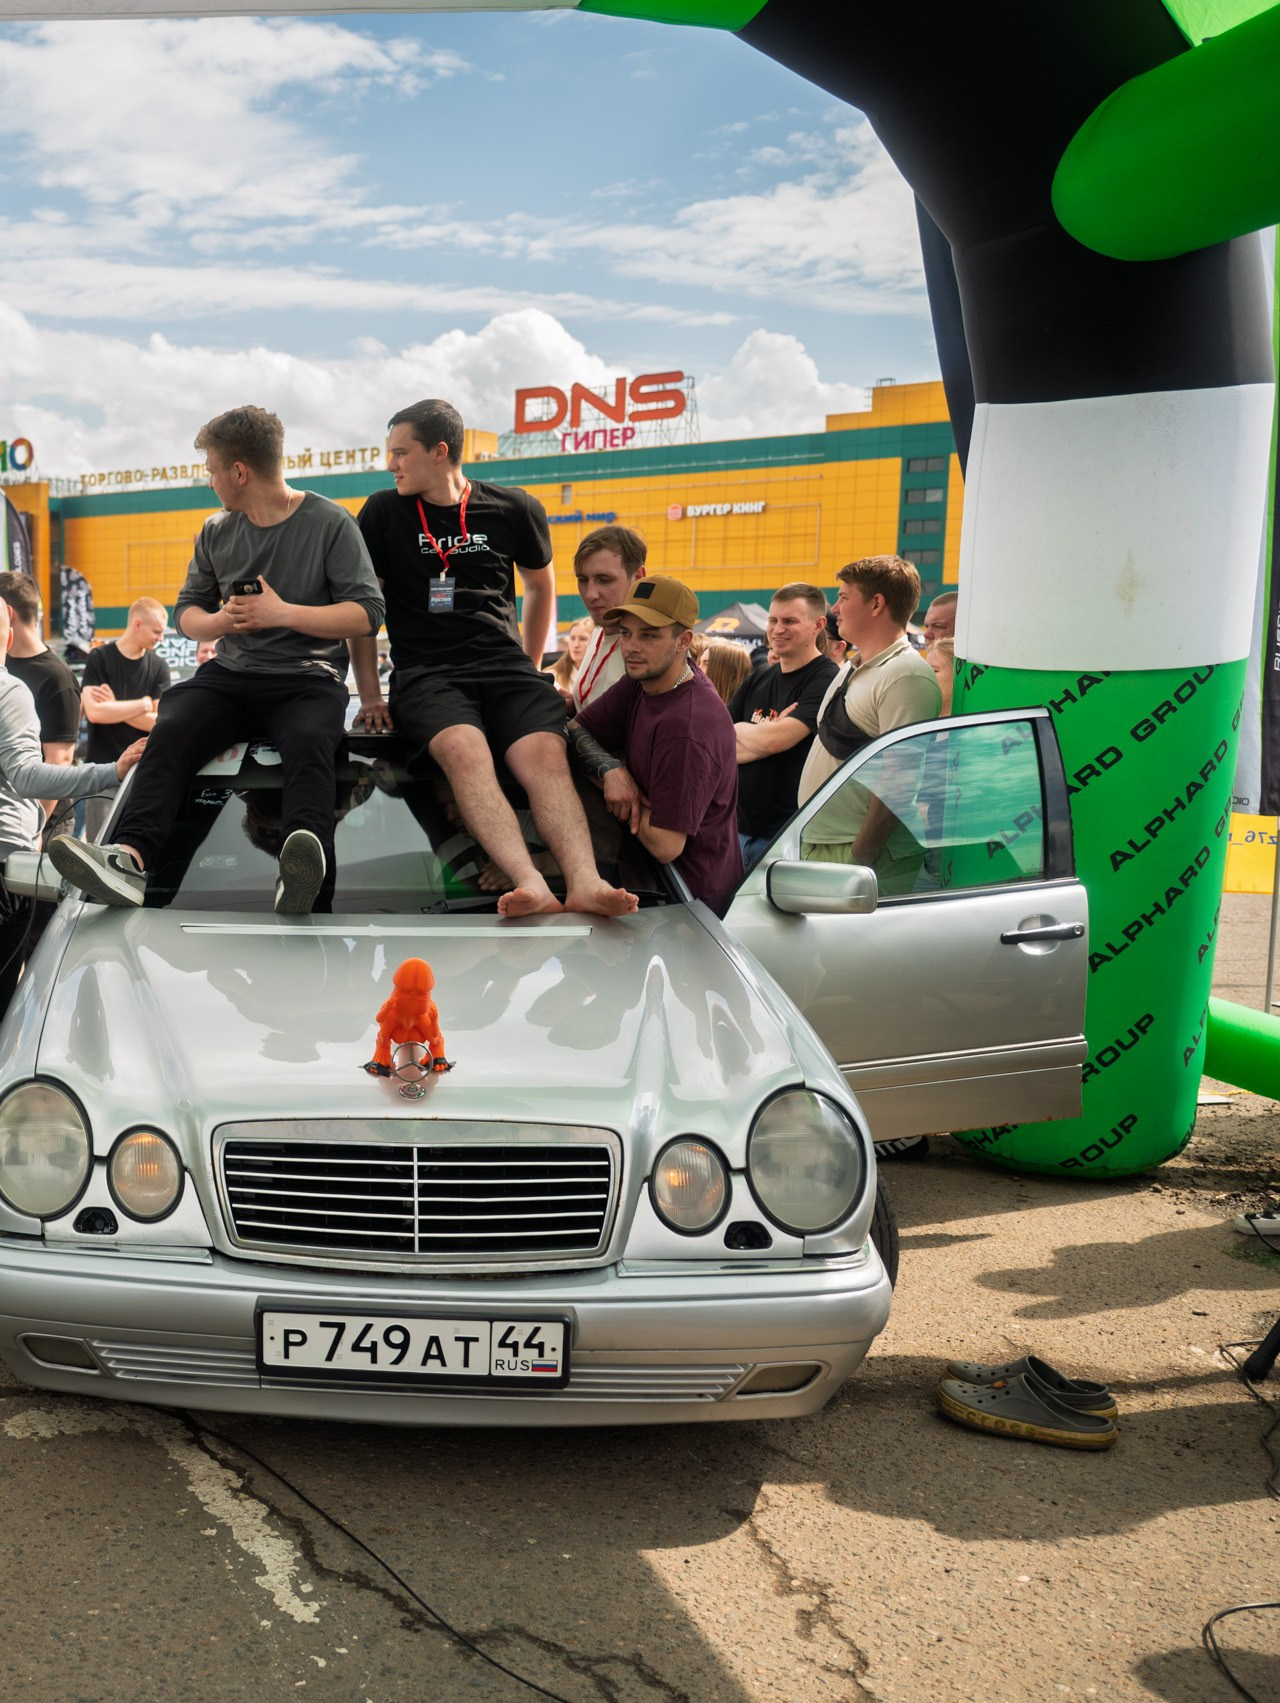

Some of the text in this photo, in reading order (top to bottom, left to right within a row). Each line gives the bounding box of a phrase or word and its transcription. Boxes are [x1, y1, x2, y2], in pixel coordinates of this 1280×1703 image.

[514, 371, 687, 434] DNS
[561, 427, 636, 453] ГИПЕР
[320, 447, 381, 467] ЦЕНТР
[547, 510, 617, 525] ский мир
[686, 503, 730, 517] БУРГЕР
[732, 501, 766, 514] КИНГ
[1130, 665, 1221, 742] GROU
[1109, 739, 1228, 873] ALPHARD
[1088, 845, 1211, 974] ALPHARD
[1082, 1013, 1154, 1083] ROUP
[497, 1325, 545, 1358] 44
[495, 1358, 530, 1371] RUS
